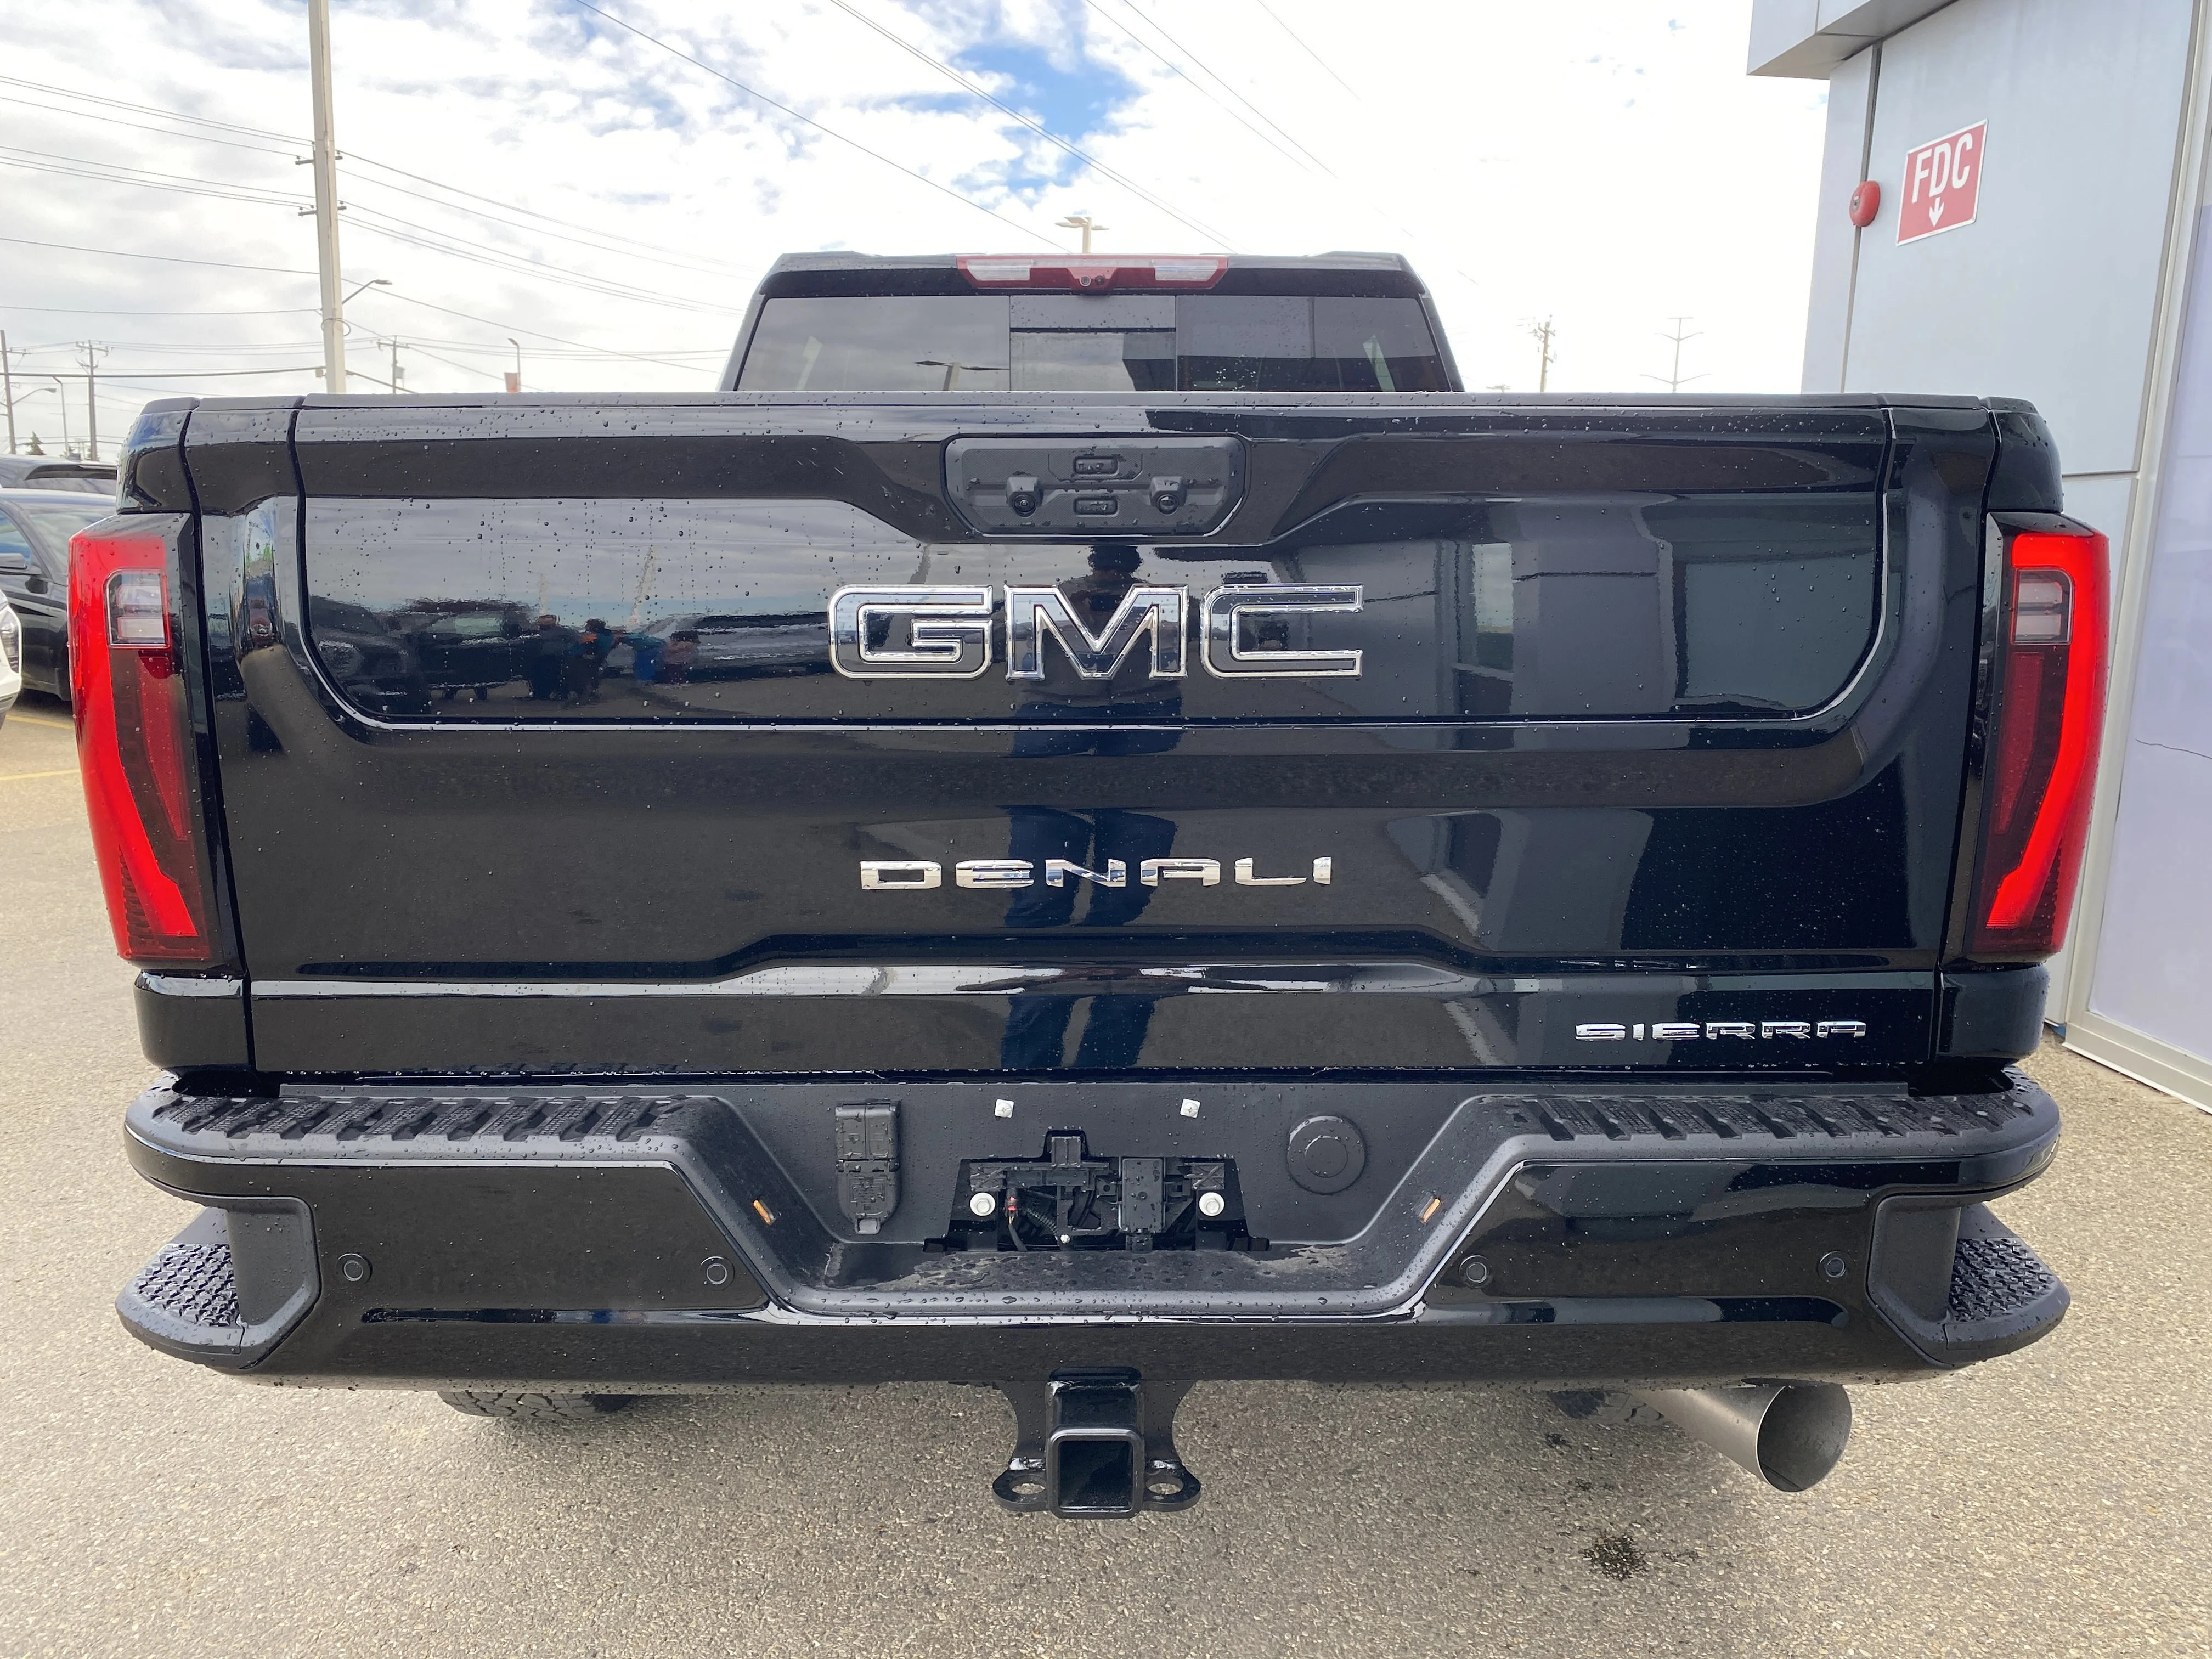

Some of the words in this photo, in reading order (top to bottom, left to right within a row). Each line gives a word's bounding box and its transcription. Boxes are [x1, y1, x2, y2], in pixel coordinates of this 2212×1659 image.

[1911, 132, 1973, 204] FDC
[828, 583, 1364, 680] GMC
[860, 856, 1332, 890] DENALI
[1575, 1020, 1866, 1041] SIERRA
